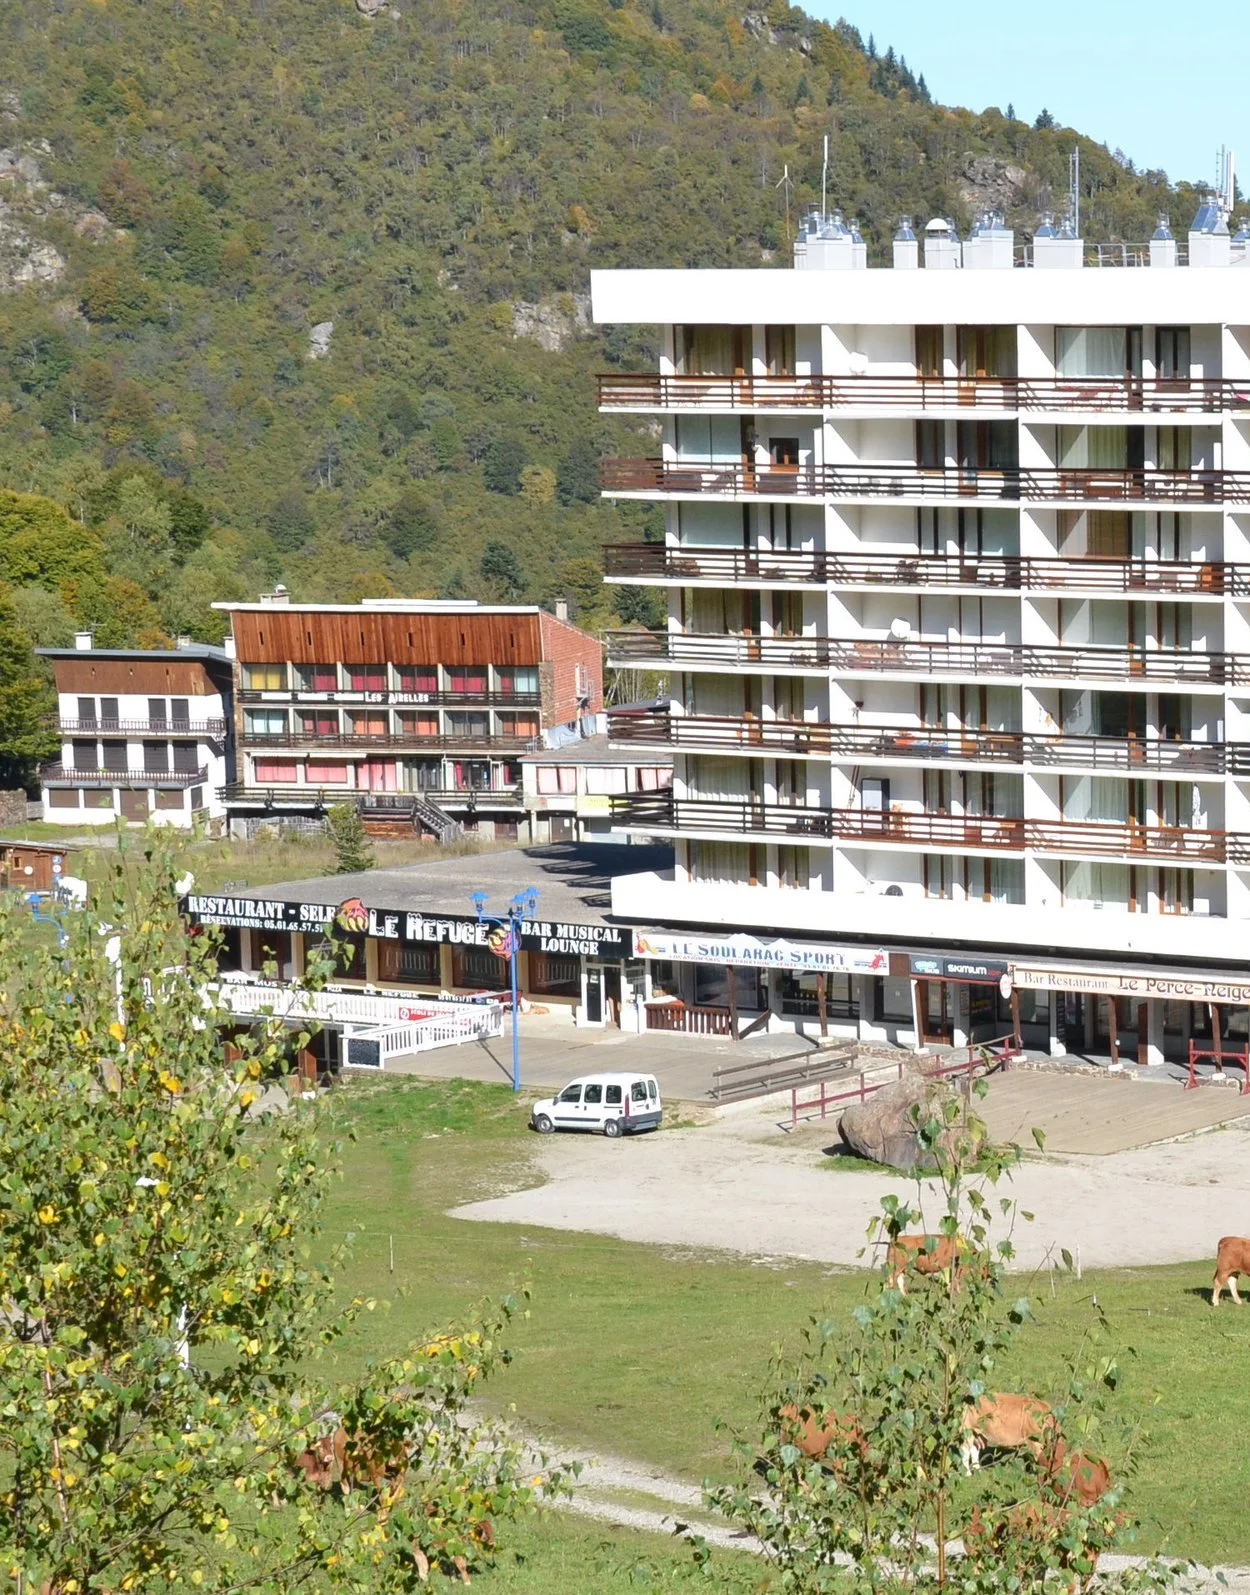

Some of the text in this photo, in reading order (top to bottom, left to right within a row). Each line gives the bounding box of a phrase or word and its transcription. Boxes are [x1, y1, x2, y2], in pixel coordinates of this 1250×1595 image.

[365, 691, 429, 704] LES AIRELLES
[188, 896, 284, 919] RESTAURANT
[300, 904, 335, 922] SELF
[368, 909, 489, 946] LE REFUGE
[521, 921, 622, 942] BAR MUSICAL
[540, 937, 599, 955] LOUNGE
[790, 950, 845, 965] SPORT
[1024, 972, 1044, 985] Bar
[1048, 973, 1108, 989] Restaurant
[1117, 975, 1139, 990] Le
